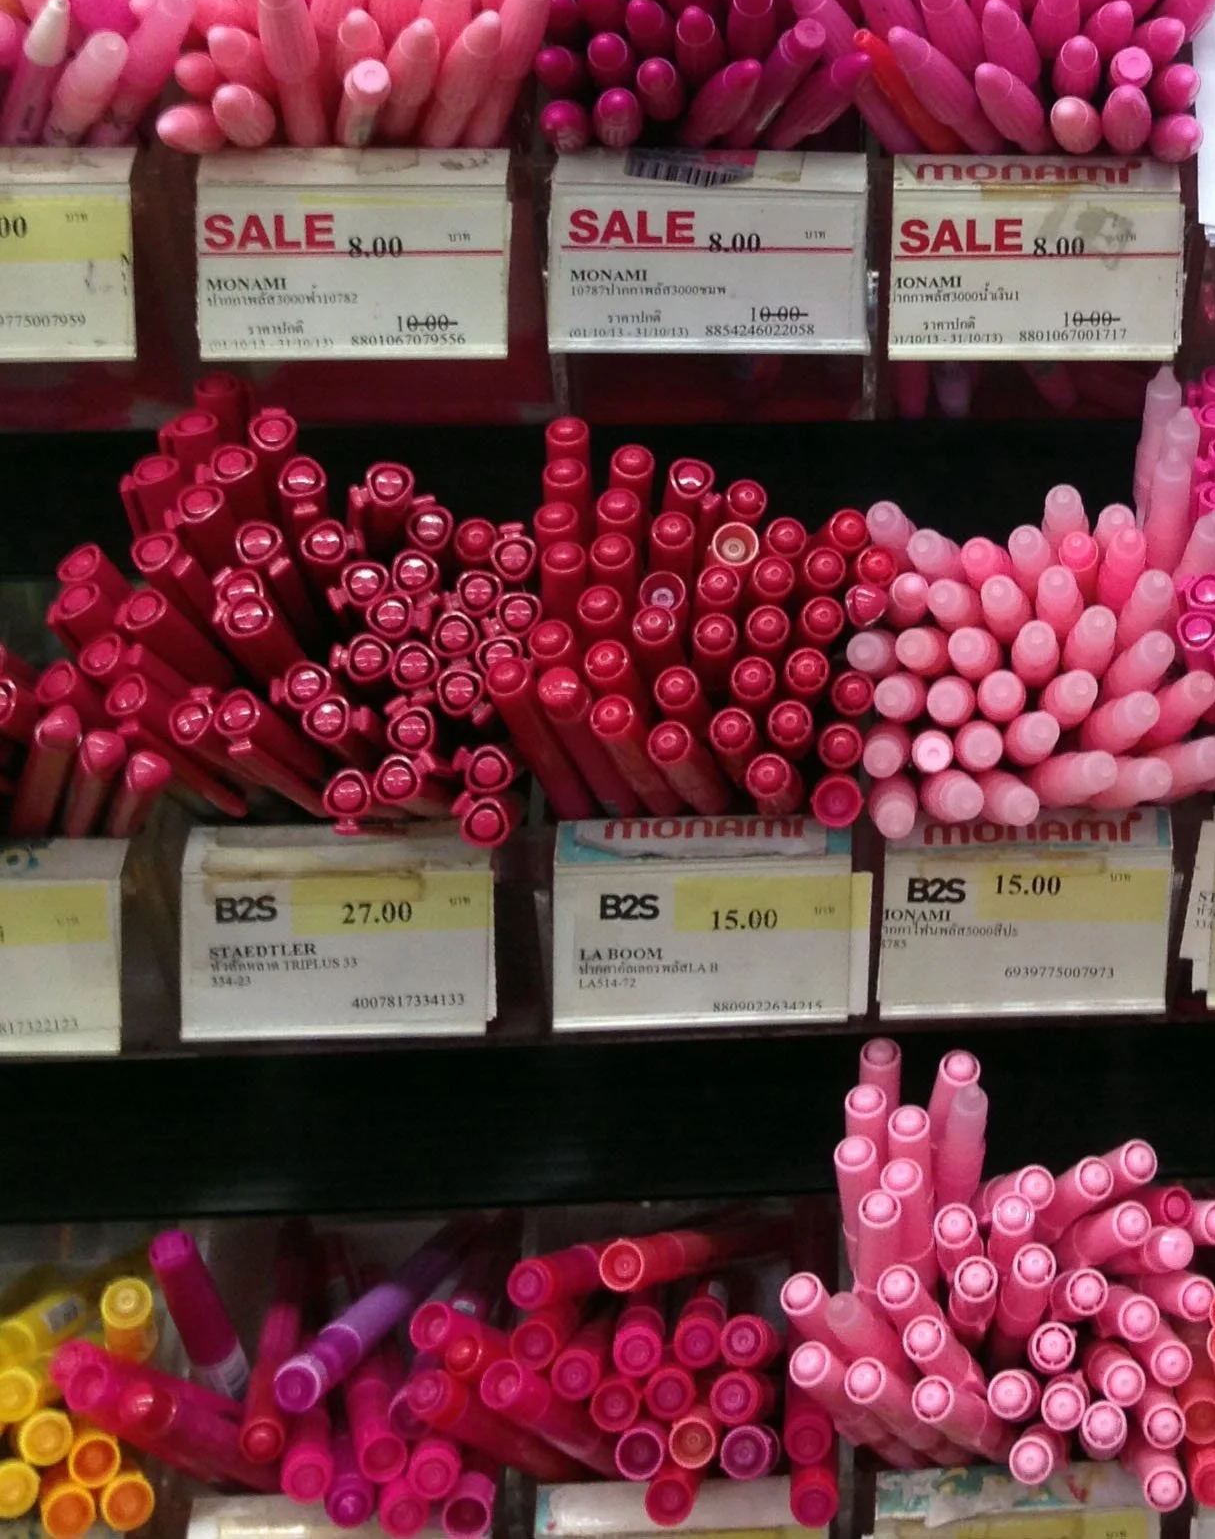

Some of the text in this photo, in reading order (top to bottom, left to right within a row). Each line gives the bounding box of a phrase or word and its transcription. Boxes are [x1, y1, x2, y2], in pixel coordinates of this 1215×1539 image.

[204, 213, 335, 251] SALE
[349, 236, 403, 258] 8.00
[569, 209, 695, 245] SALE
[709, 232, 761, 253] 8.00
[900, 219, 1084, 257] SALE 8.00
[571, 269, 647, 281] MONAMI
[207, 277, 287, 291] MONAMI
[705, 324, 815, 337] 8854246022058
[1019, 328, 1127, 342] 8801067001717
[351, 333, 466, 347] 8801067079556
[907, 877, 966, 903] B2S
[995, 874, 1061, 896] 15.00
[215, 895, 278, 924] B2S
[343, 901, 412, 925] 27.00
[600, 894, 660, 920] B2S
[712, 909, 777, 930] 15.00
[209, 943, 316, 958] STAEDTLER
[580, 948, 663, 961] LA BOOM
[285, 958, 340, 970] TRIPLUS
[343, 958, 357, 968] 33
[1004, 967, 1114, 979] 6939775007973
[579, 978, 636, 989] LA514-72
[351, 994, 465, 1009] 4007817334133
